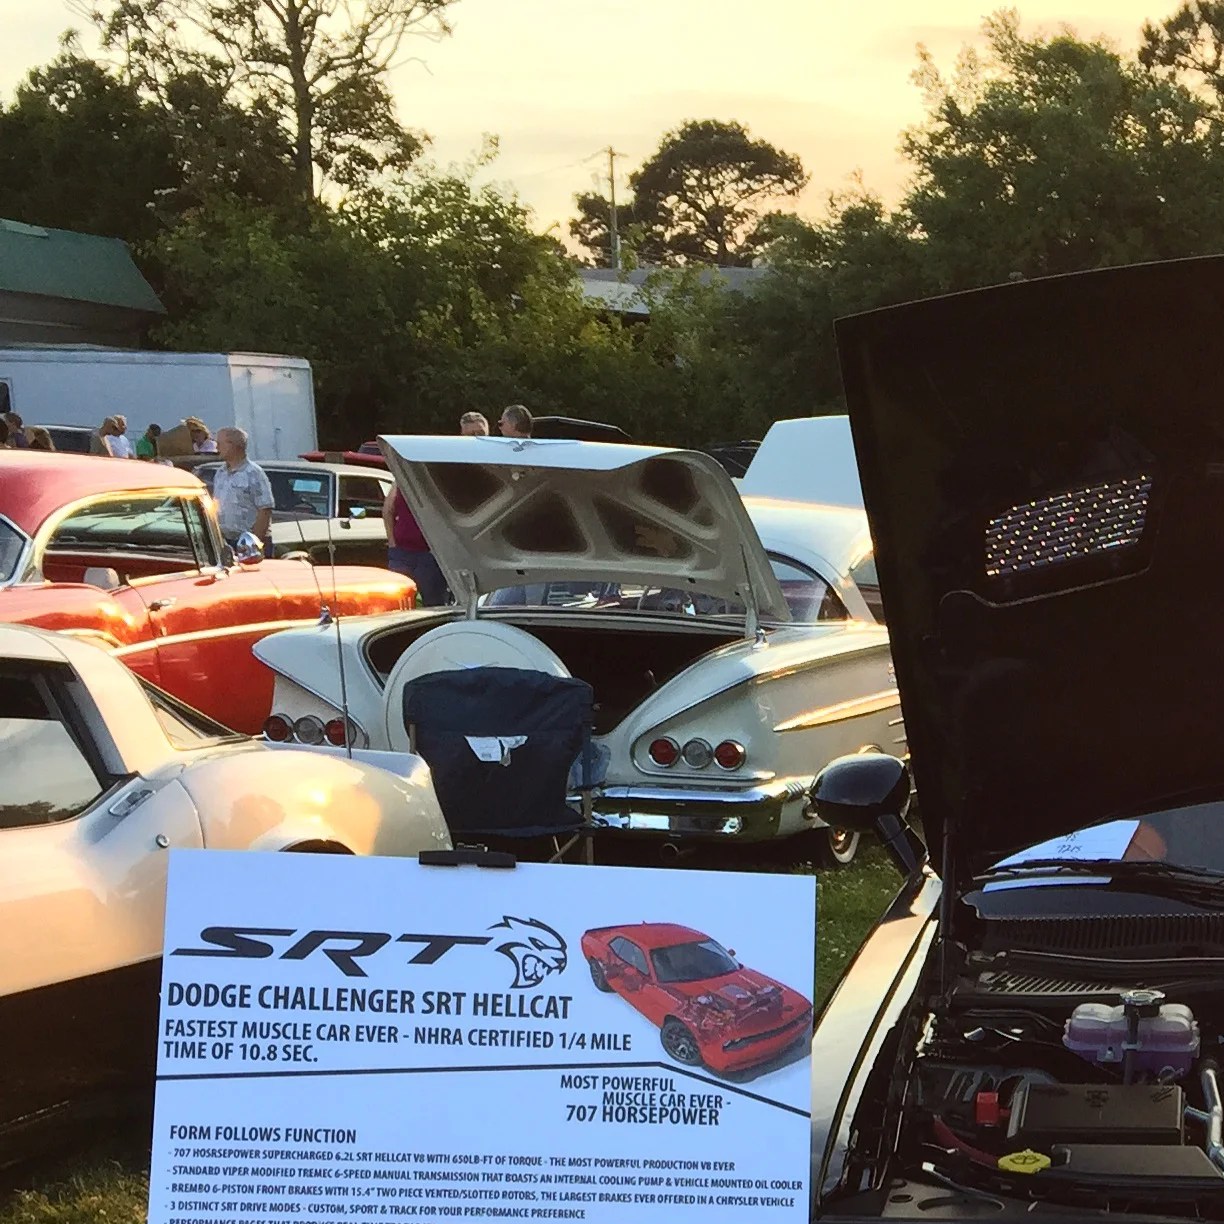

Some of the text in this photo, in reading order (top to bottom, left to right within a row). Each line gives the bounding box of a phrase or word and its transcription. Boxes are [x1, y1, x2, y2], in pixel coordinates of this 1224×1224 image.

[170, 925, 492, 977] SRT
[167, 981, 573, 1019] DODGE CHALLENGER SRT HELLCAT
[164, 1018, 238, 1038] FASTEST
[241, 1020, 312, 1040] MUSCLE
[315, 1023, 351, 1042] CAR
[355, 1024, 399, 1043] EVER
[413, 1026, 464, 1045] NHRA
[467, 1028, 554, 1048] CERTIFIED
[590, 1032, 631, 1051] MILE
[162, 1040, 319, 1062] TIME OF 10.8 SEC.
[560, 1074, 677, 1092] MOST POWERFUL
[602, 1091, 723, 1109] MUSCLE CAR EVER
[565, 1103, 722, 1126] 707 HORSEPOWER
[169, 1124, 356, 1144] FORM FOLLOWS FUNCTION
[173, 1147, 191, 1157] 707
[261, 1149, 333, 1160] SUPERCHARGED
[334, 1151, 354, 1161] 6.2L
[355, 1151, 373, 1161] SRT
[374, 1152, 412, 1163] HELLCAT
[412, 1153, 425, 1163] V8
[426, 1153, 450, 1163] WITH
[451, 1154, 493, 1164] 650LB-FT
[494, 1155, 506, 1165] OF
[507, 1155, 542, 1167] TORQUE
[548, 1156, 566, 1166] THE
[567, 1157, 592, 1167] MOST
[594, 1158, 641, 1168] POWERFUL
[642, 1159, 698, 1170] PRODUCTION
[700, 1161, 711, 1170] V8
[713, 1161, 735, 1171] EVER
[170, 1200, 176, 1210] 3
[177, 1200, 219, 1211] DISTINCT
[220, 1201, 238, 1212] SRT
[239, 1201, 267, 1212] DRIVE
[268, 1202, 301, 1213] MODES
[349, 1203, 378, 1214] SPORT
[388, 1205, 418, 1215] TRACK
[418, 1205, 437, 1215] FOR
[437, 1206, 462, 1216] YOUR
[464, 1206, 529, 1218] PERFORMANCE
[530, 1208, 585, 1219] PREFERENCE
